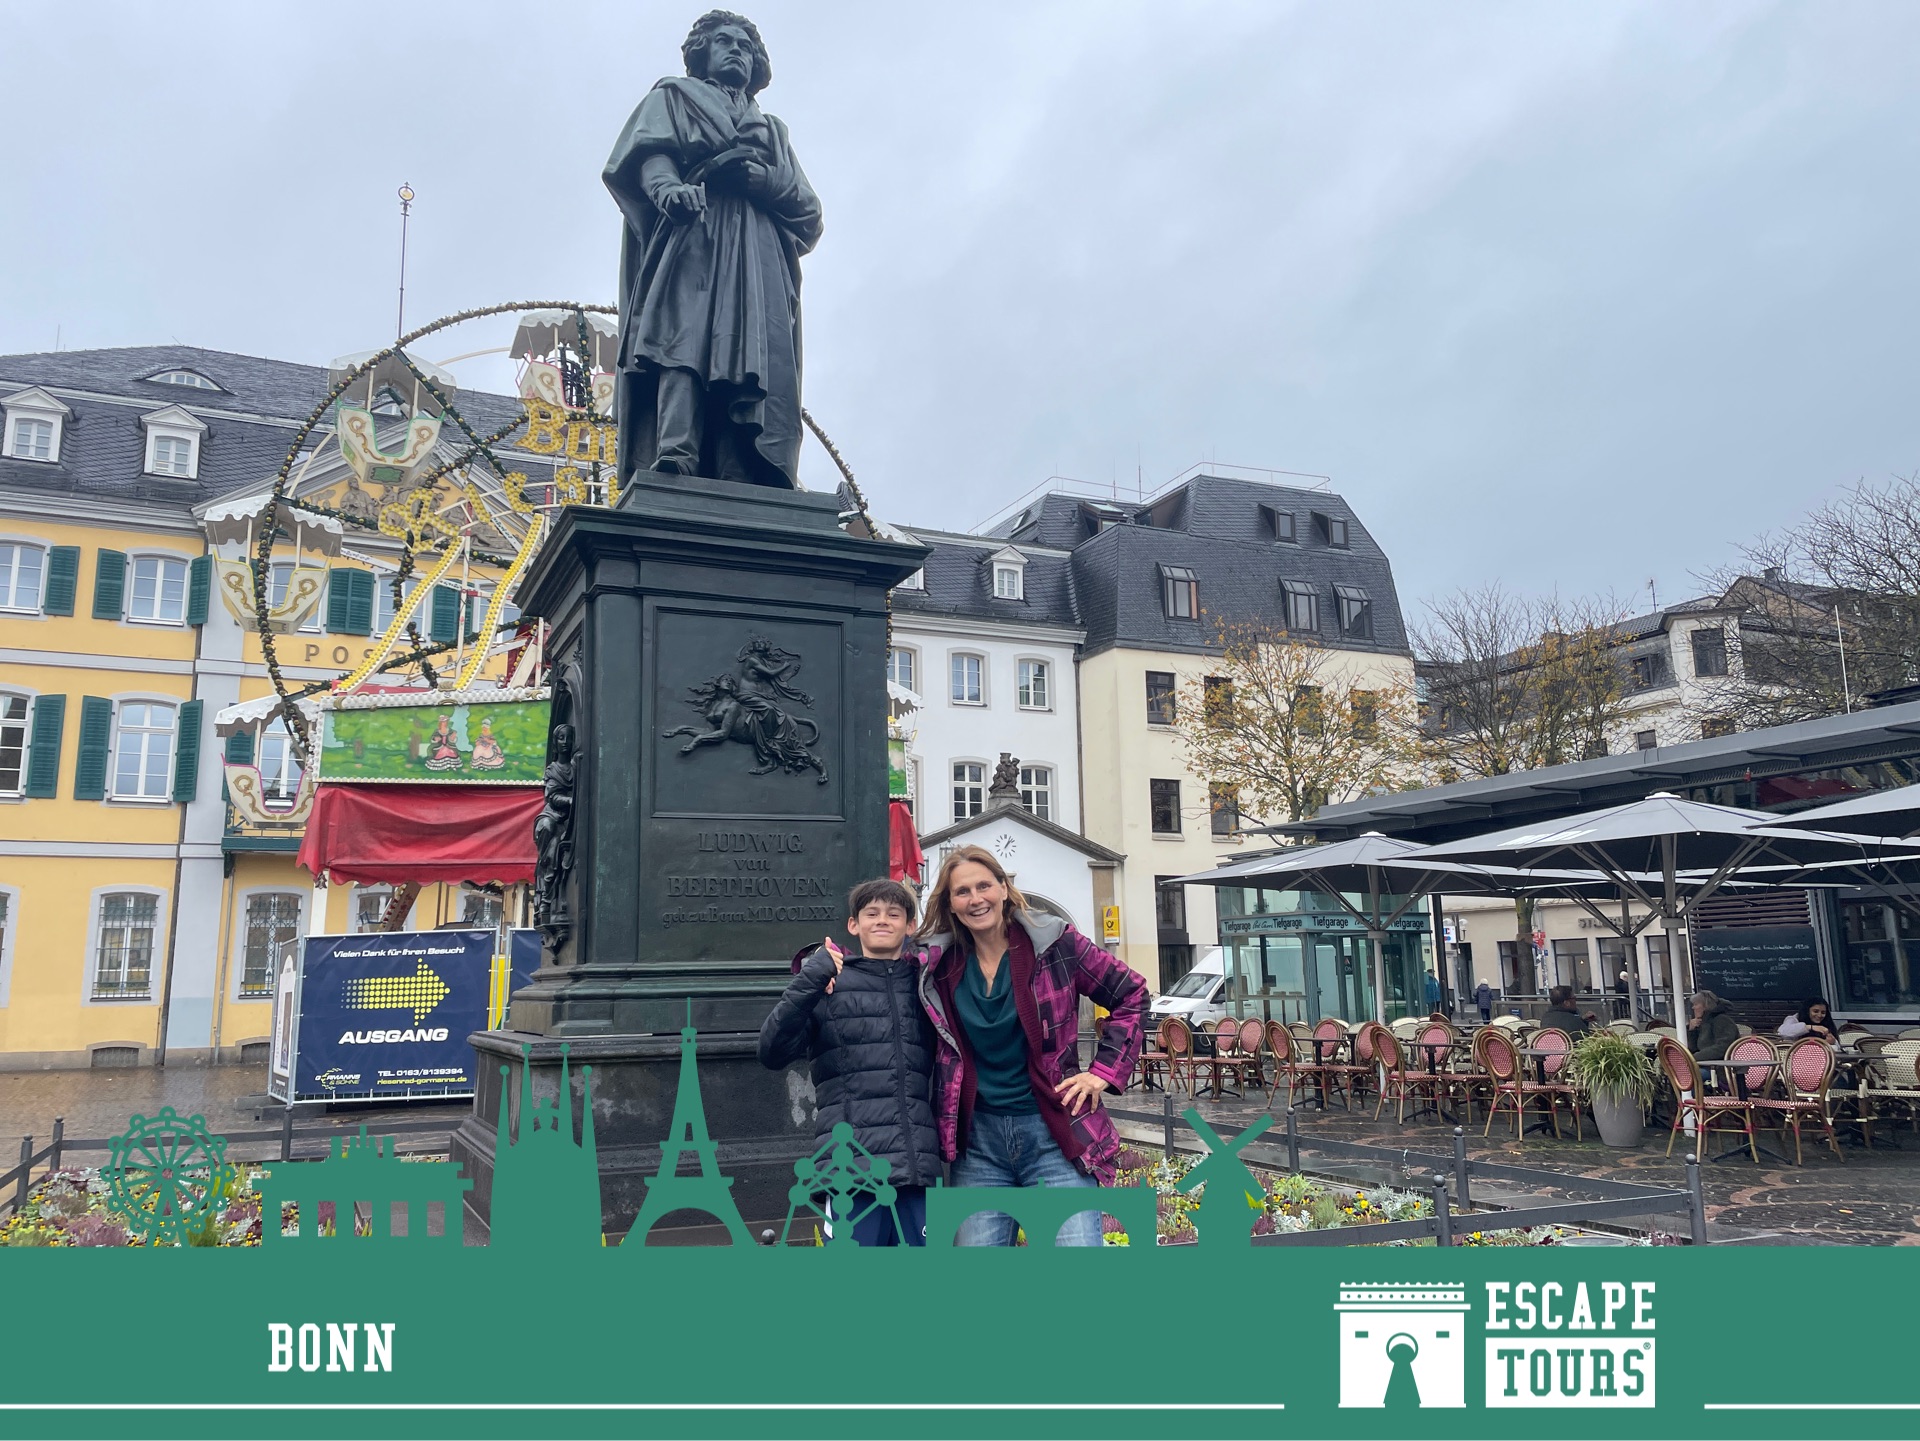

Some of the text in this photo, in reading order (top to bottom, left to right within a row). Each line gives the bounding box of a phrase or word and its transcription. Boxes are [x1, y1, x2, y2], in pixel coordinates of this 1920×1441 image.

[699, 832, 803, 853] LUDWIG
[734, 858, 770, 871] van
[708, 906, 747, 923] Bonn
[1312, 916, 1349, 928] Tiefgarage
[1224, 921, 1251, 933] Tiefgarage
[1273, 917, 1302, 930] Tiefgarage
[333, 946, 465, 958] Vielen Dank für Ihren Besuch!
[338, 1028, 449, 1044] AUSGANG
